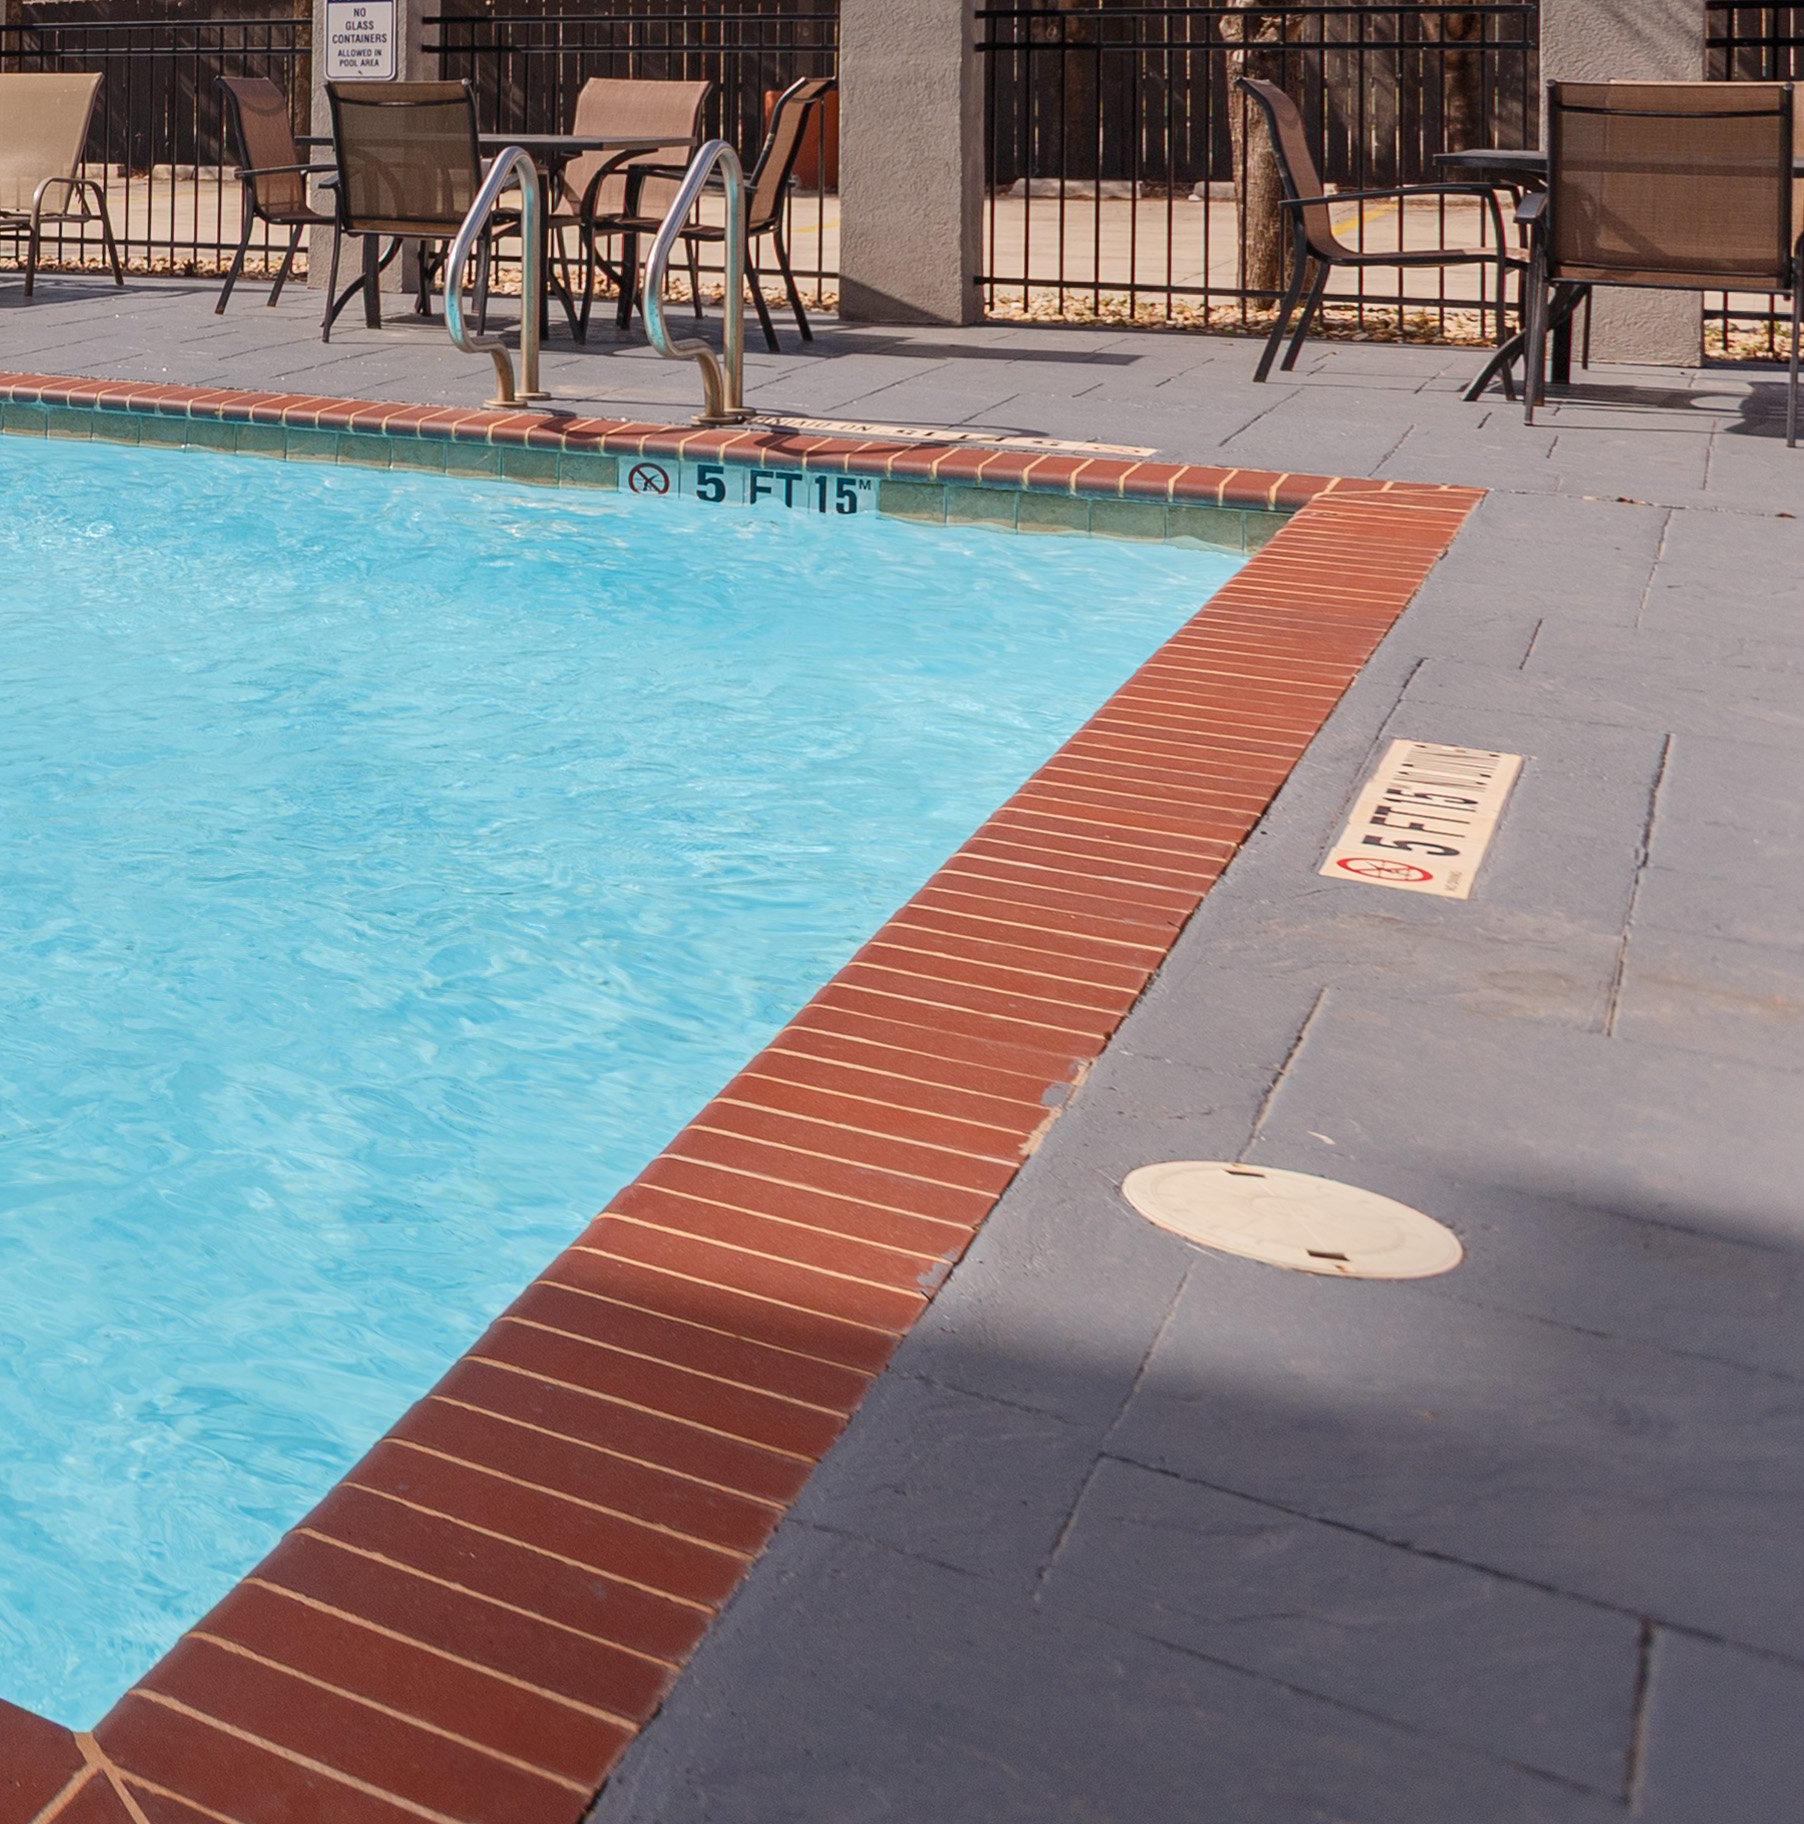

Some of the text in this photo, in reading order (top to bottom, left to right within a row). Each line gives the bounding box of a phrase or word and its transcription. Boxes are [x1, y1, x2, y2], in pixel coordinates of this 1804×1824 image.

[354, 8, 366, 17] NO
[346, 22, 374, 30] GLASS
[332, 34, 387, 44] CONTAINERS
[340, 59, 357, 67] POOL
[696, 465, 726, 503] 5
[750, 470, 803, 508] FT
[1369, 805, 1471, 838] FT
[1362, 835, 1460, 856] 5
